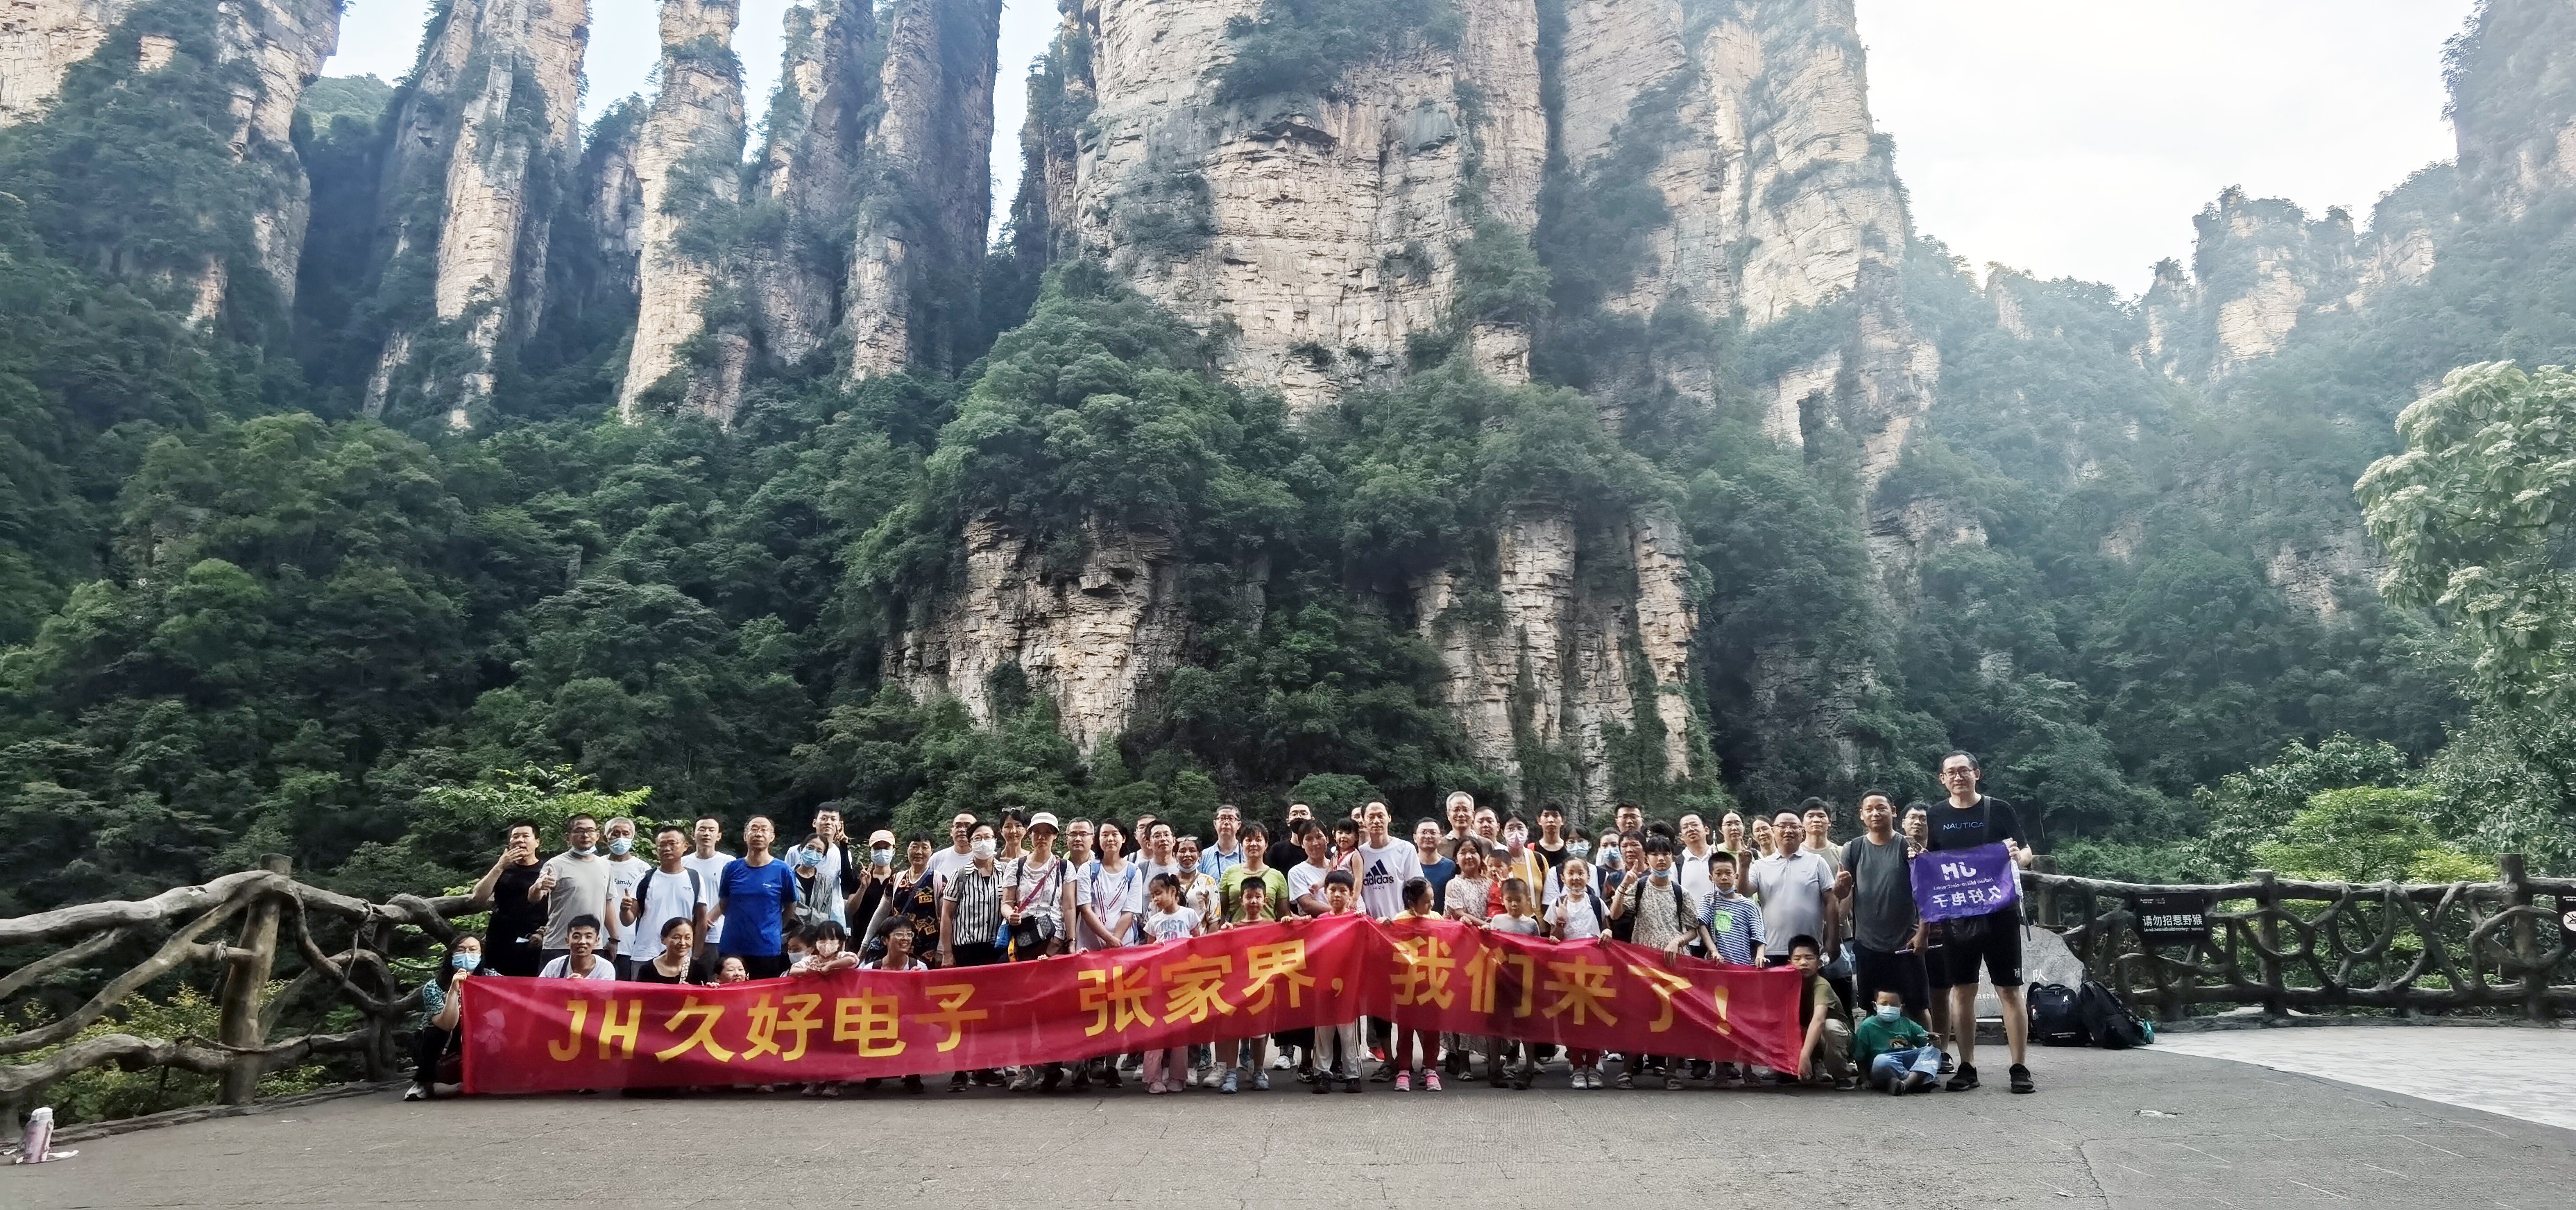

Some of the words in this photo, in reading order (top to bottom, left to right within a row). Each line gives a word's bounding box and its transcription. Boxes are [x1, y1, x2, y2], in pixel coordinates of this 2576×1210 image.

[1943, 821, 1984, 830] NAUTICA
[1363, 875, 1394, 886] adidas
[2142, 914, 2203, 927] 请勿招惹野猴
